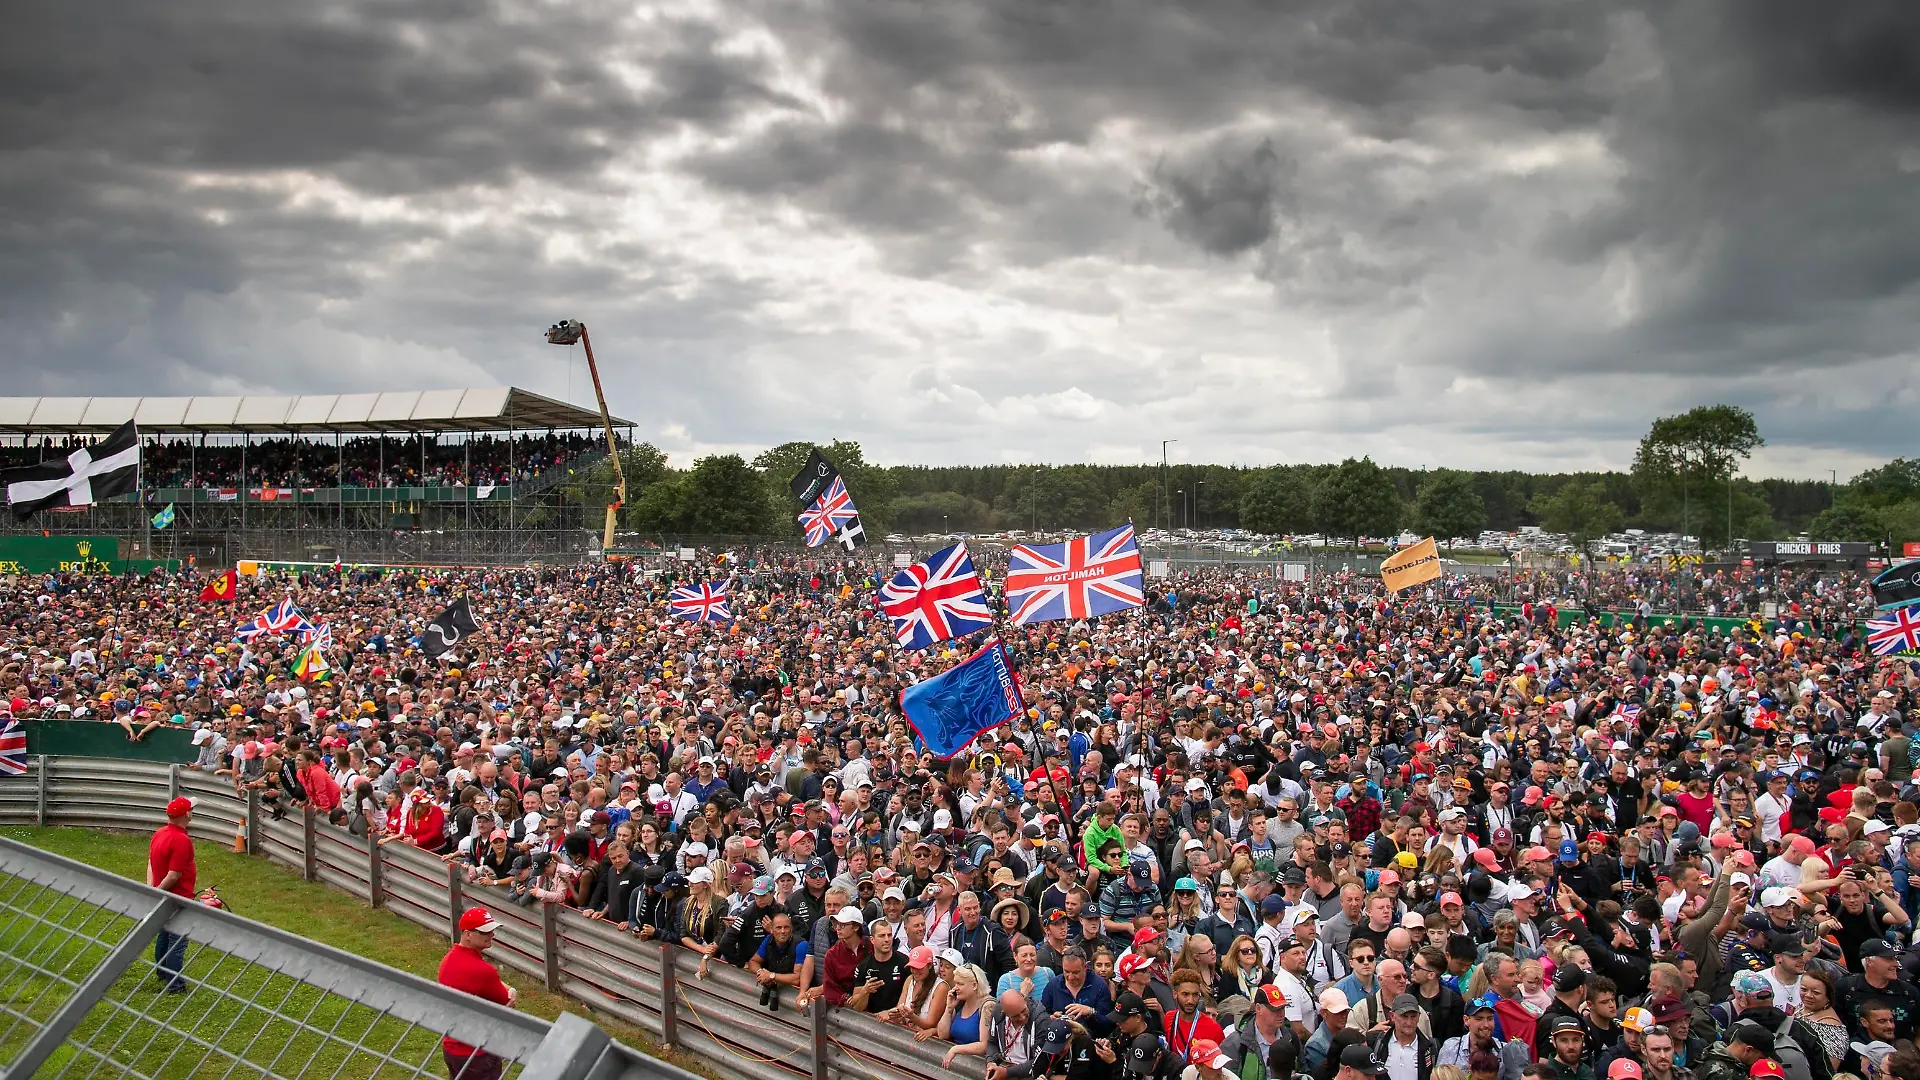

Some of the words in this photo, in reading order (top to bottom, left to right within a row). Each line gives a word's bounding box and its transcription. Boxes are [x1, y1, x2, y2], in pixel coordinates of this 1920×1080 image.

[1776, 543, 1811, 555] CHICKEN
[1817, 543, 1841, 555] FRIES
[1251, 849, 1274, 860] ARIS
